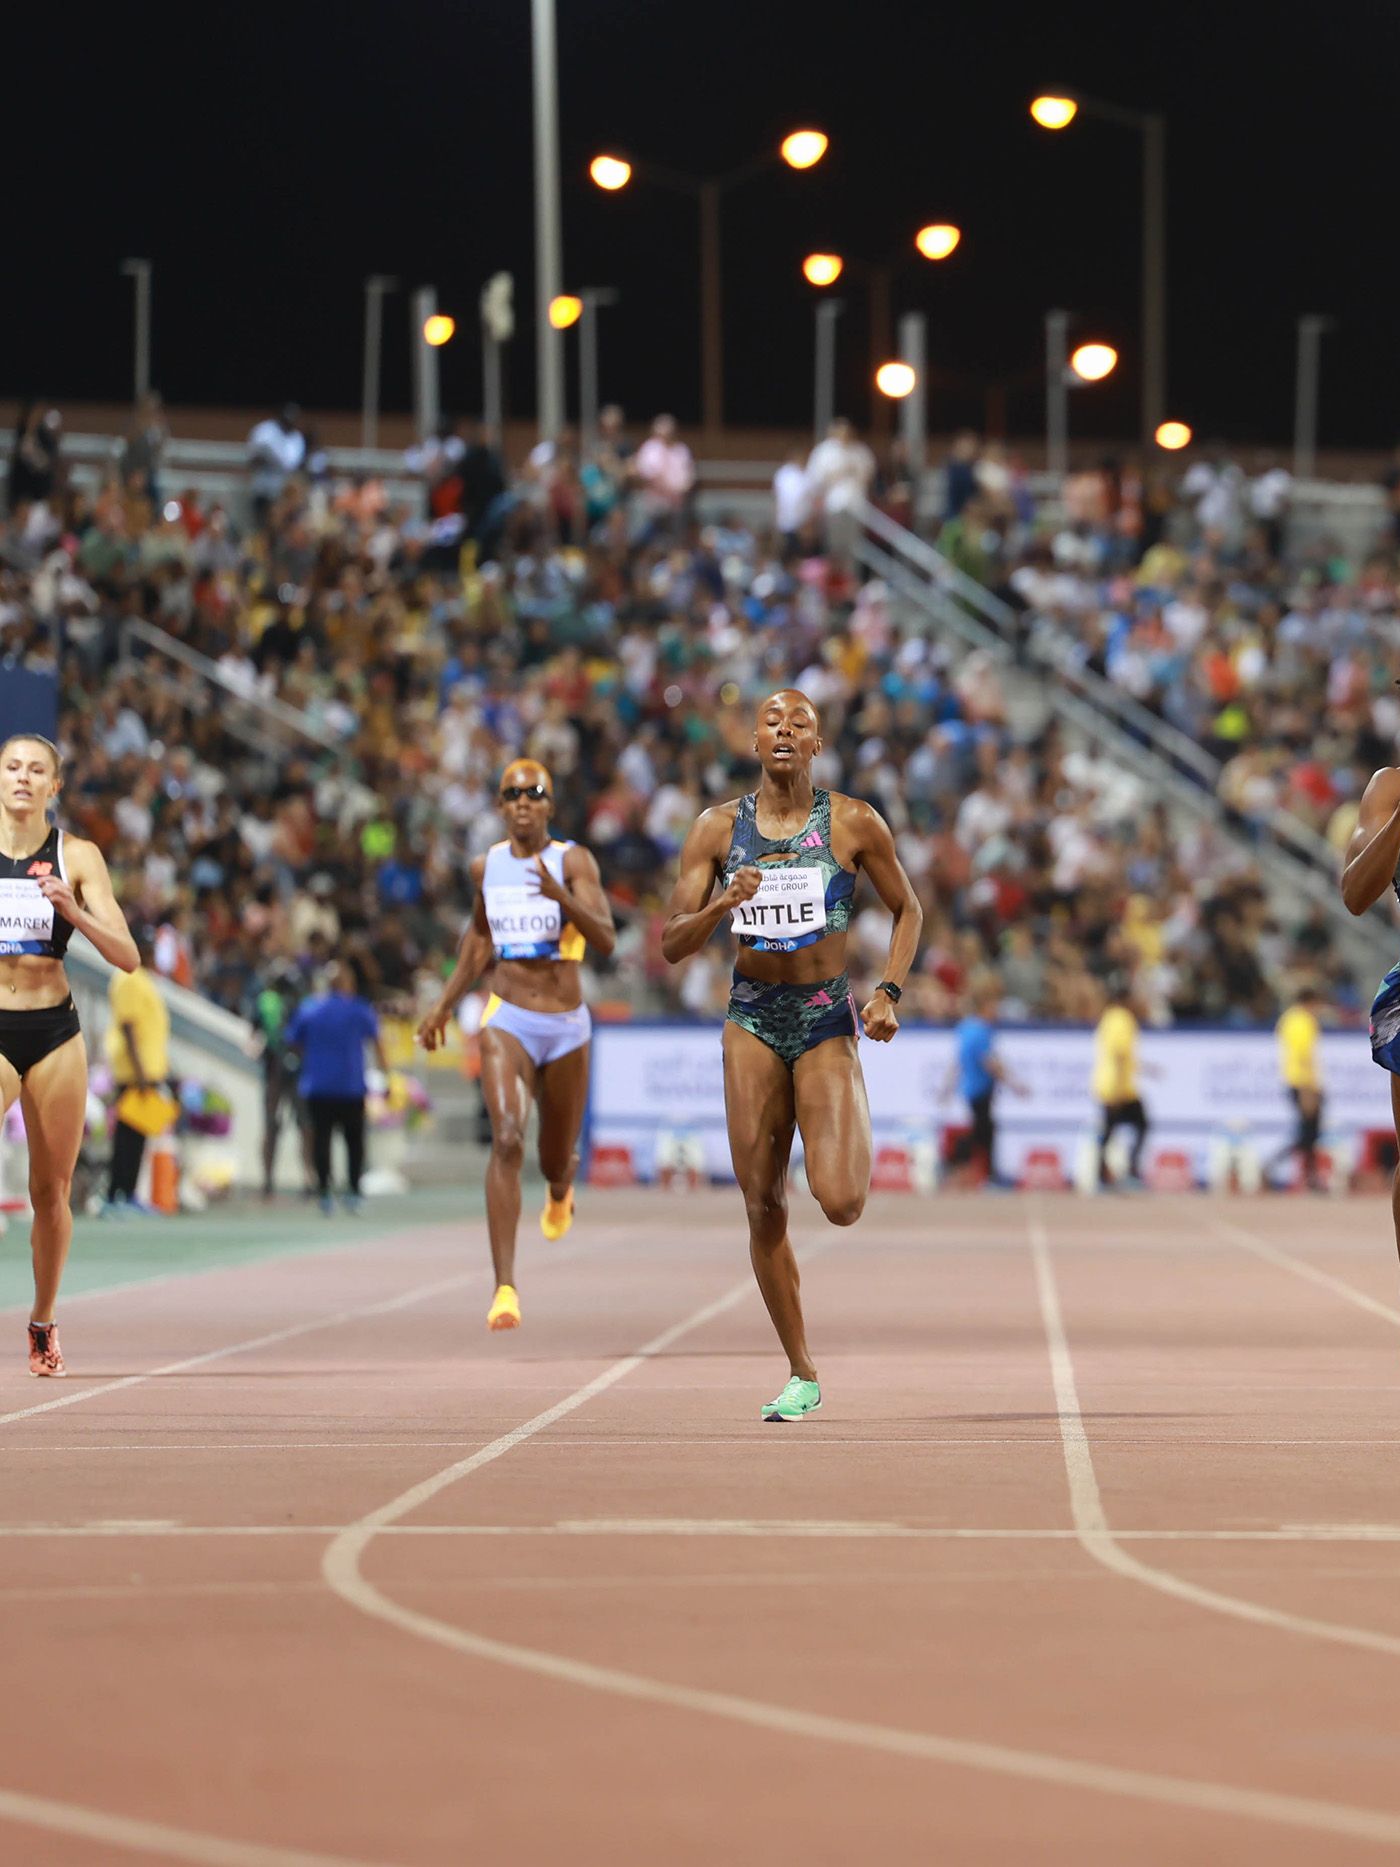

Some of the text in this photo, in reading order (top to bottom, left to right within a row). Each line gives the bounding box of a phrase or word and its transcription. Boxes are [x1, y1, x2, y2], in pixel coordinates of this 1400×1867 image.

[781, 882, 808, 891] GROUP
[740, 903, 813, 925] LITTLE
[490, 915, 557, 933] MCLEOD
[763, 940, 796, 951] DOHA
